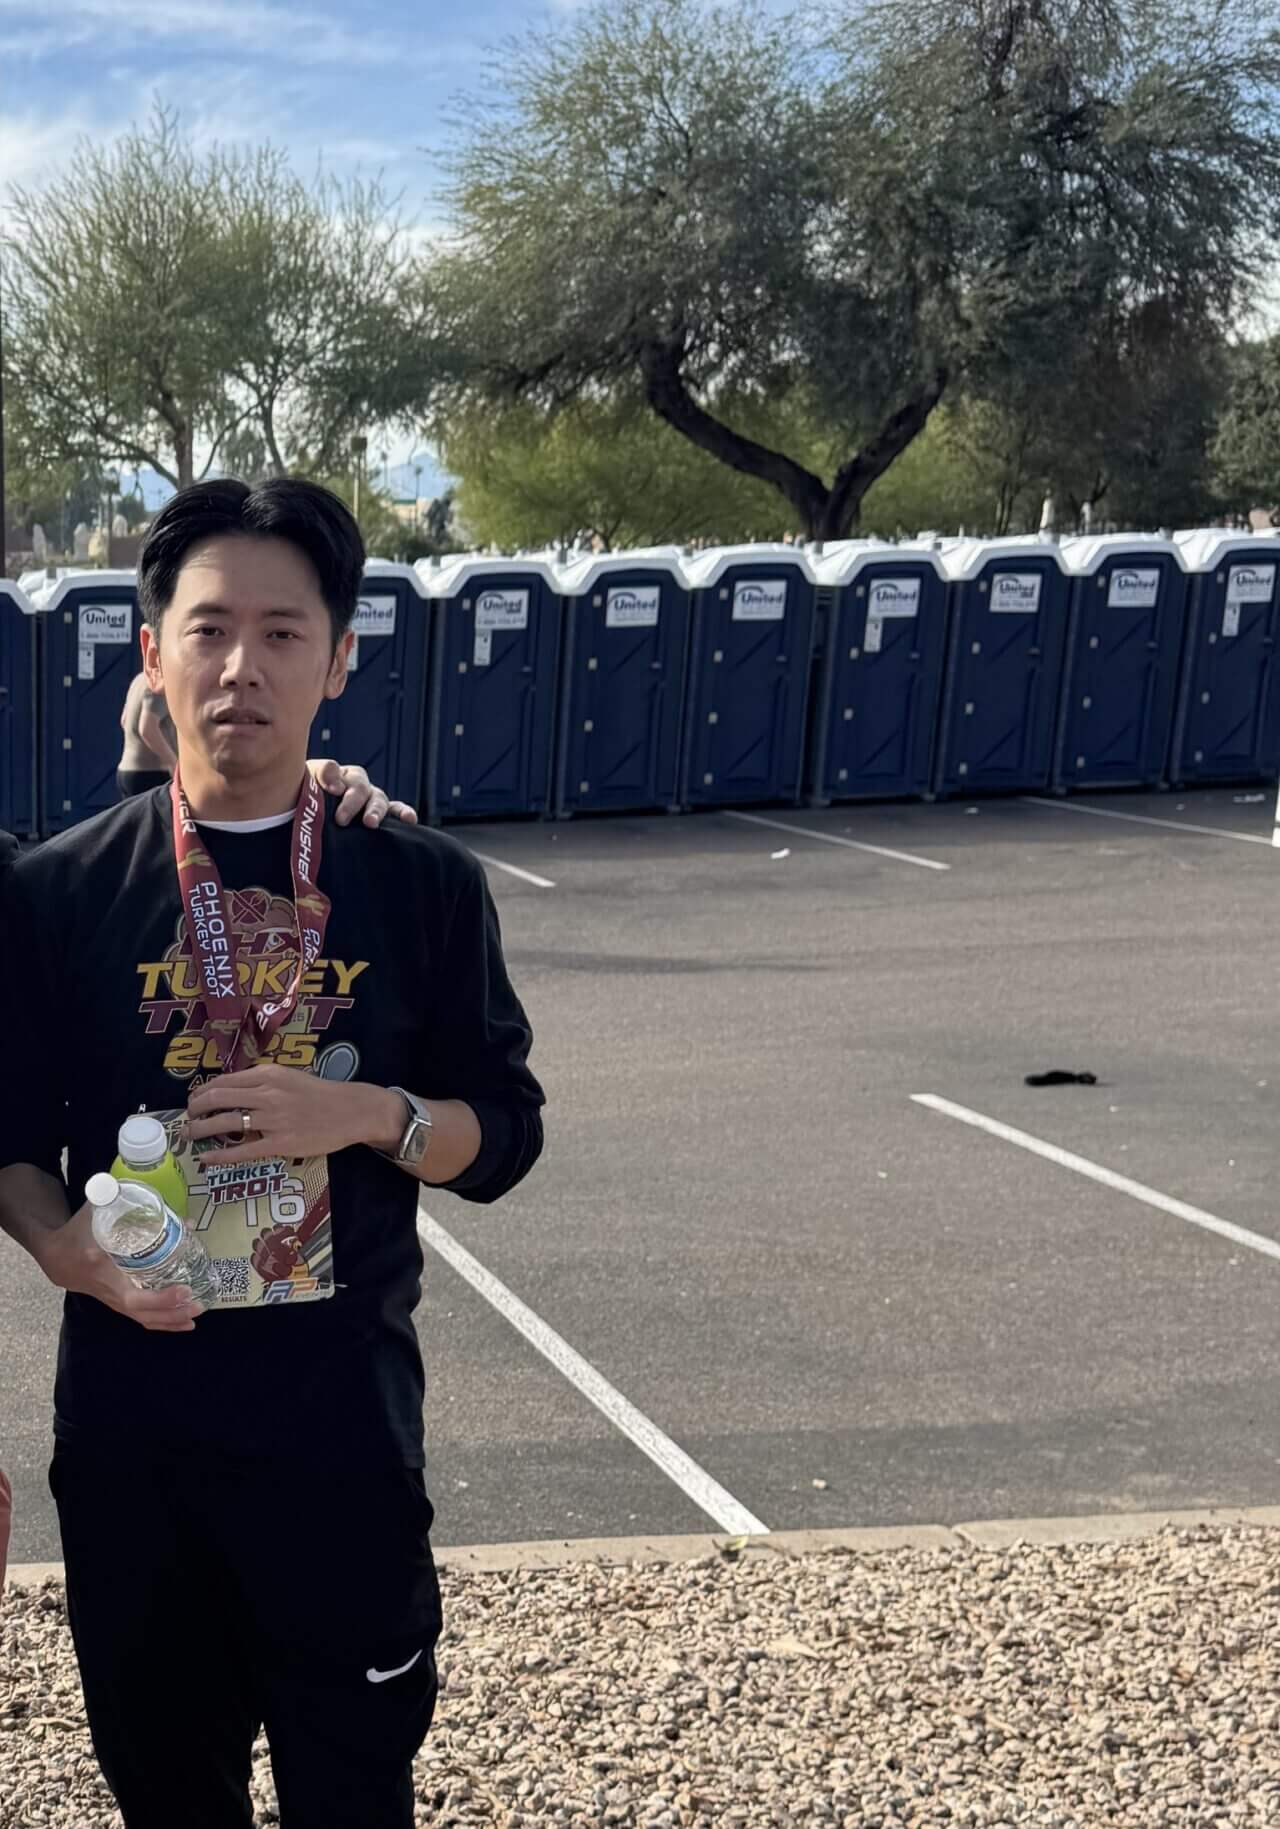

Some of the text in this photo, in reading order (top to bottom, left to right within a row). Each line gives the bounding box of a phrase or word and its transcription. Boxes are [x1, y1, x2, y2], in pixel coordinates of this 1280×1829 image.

[483, 598, 522, 610] United
[614, 598, 656, 611] United
[86, 613, 126, 625] United
[189, 884, 220, 998] TURKEY TROT
[201, 881, 236, 998] PHOENIX
[207, 1160, 287, 1187] TURKEY
[209, 1173, 289, 1206] TROT
